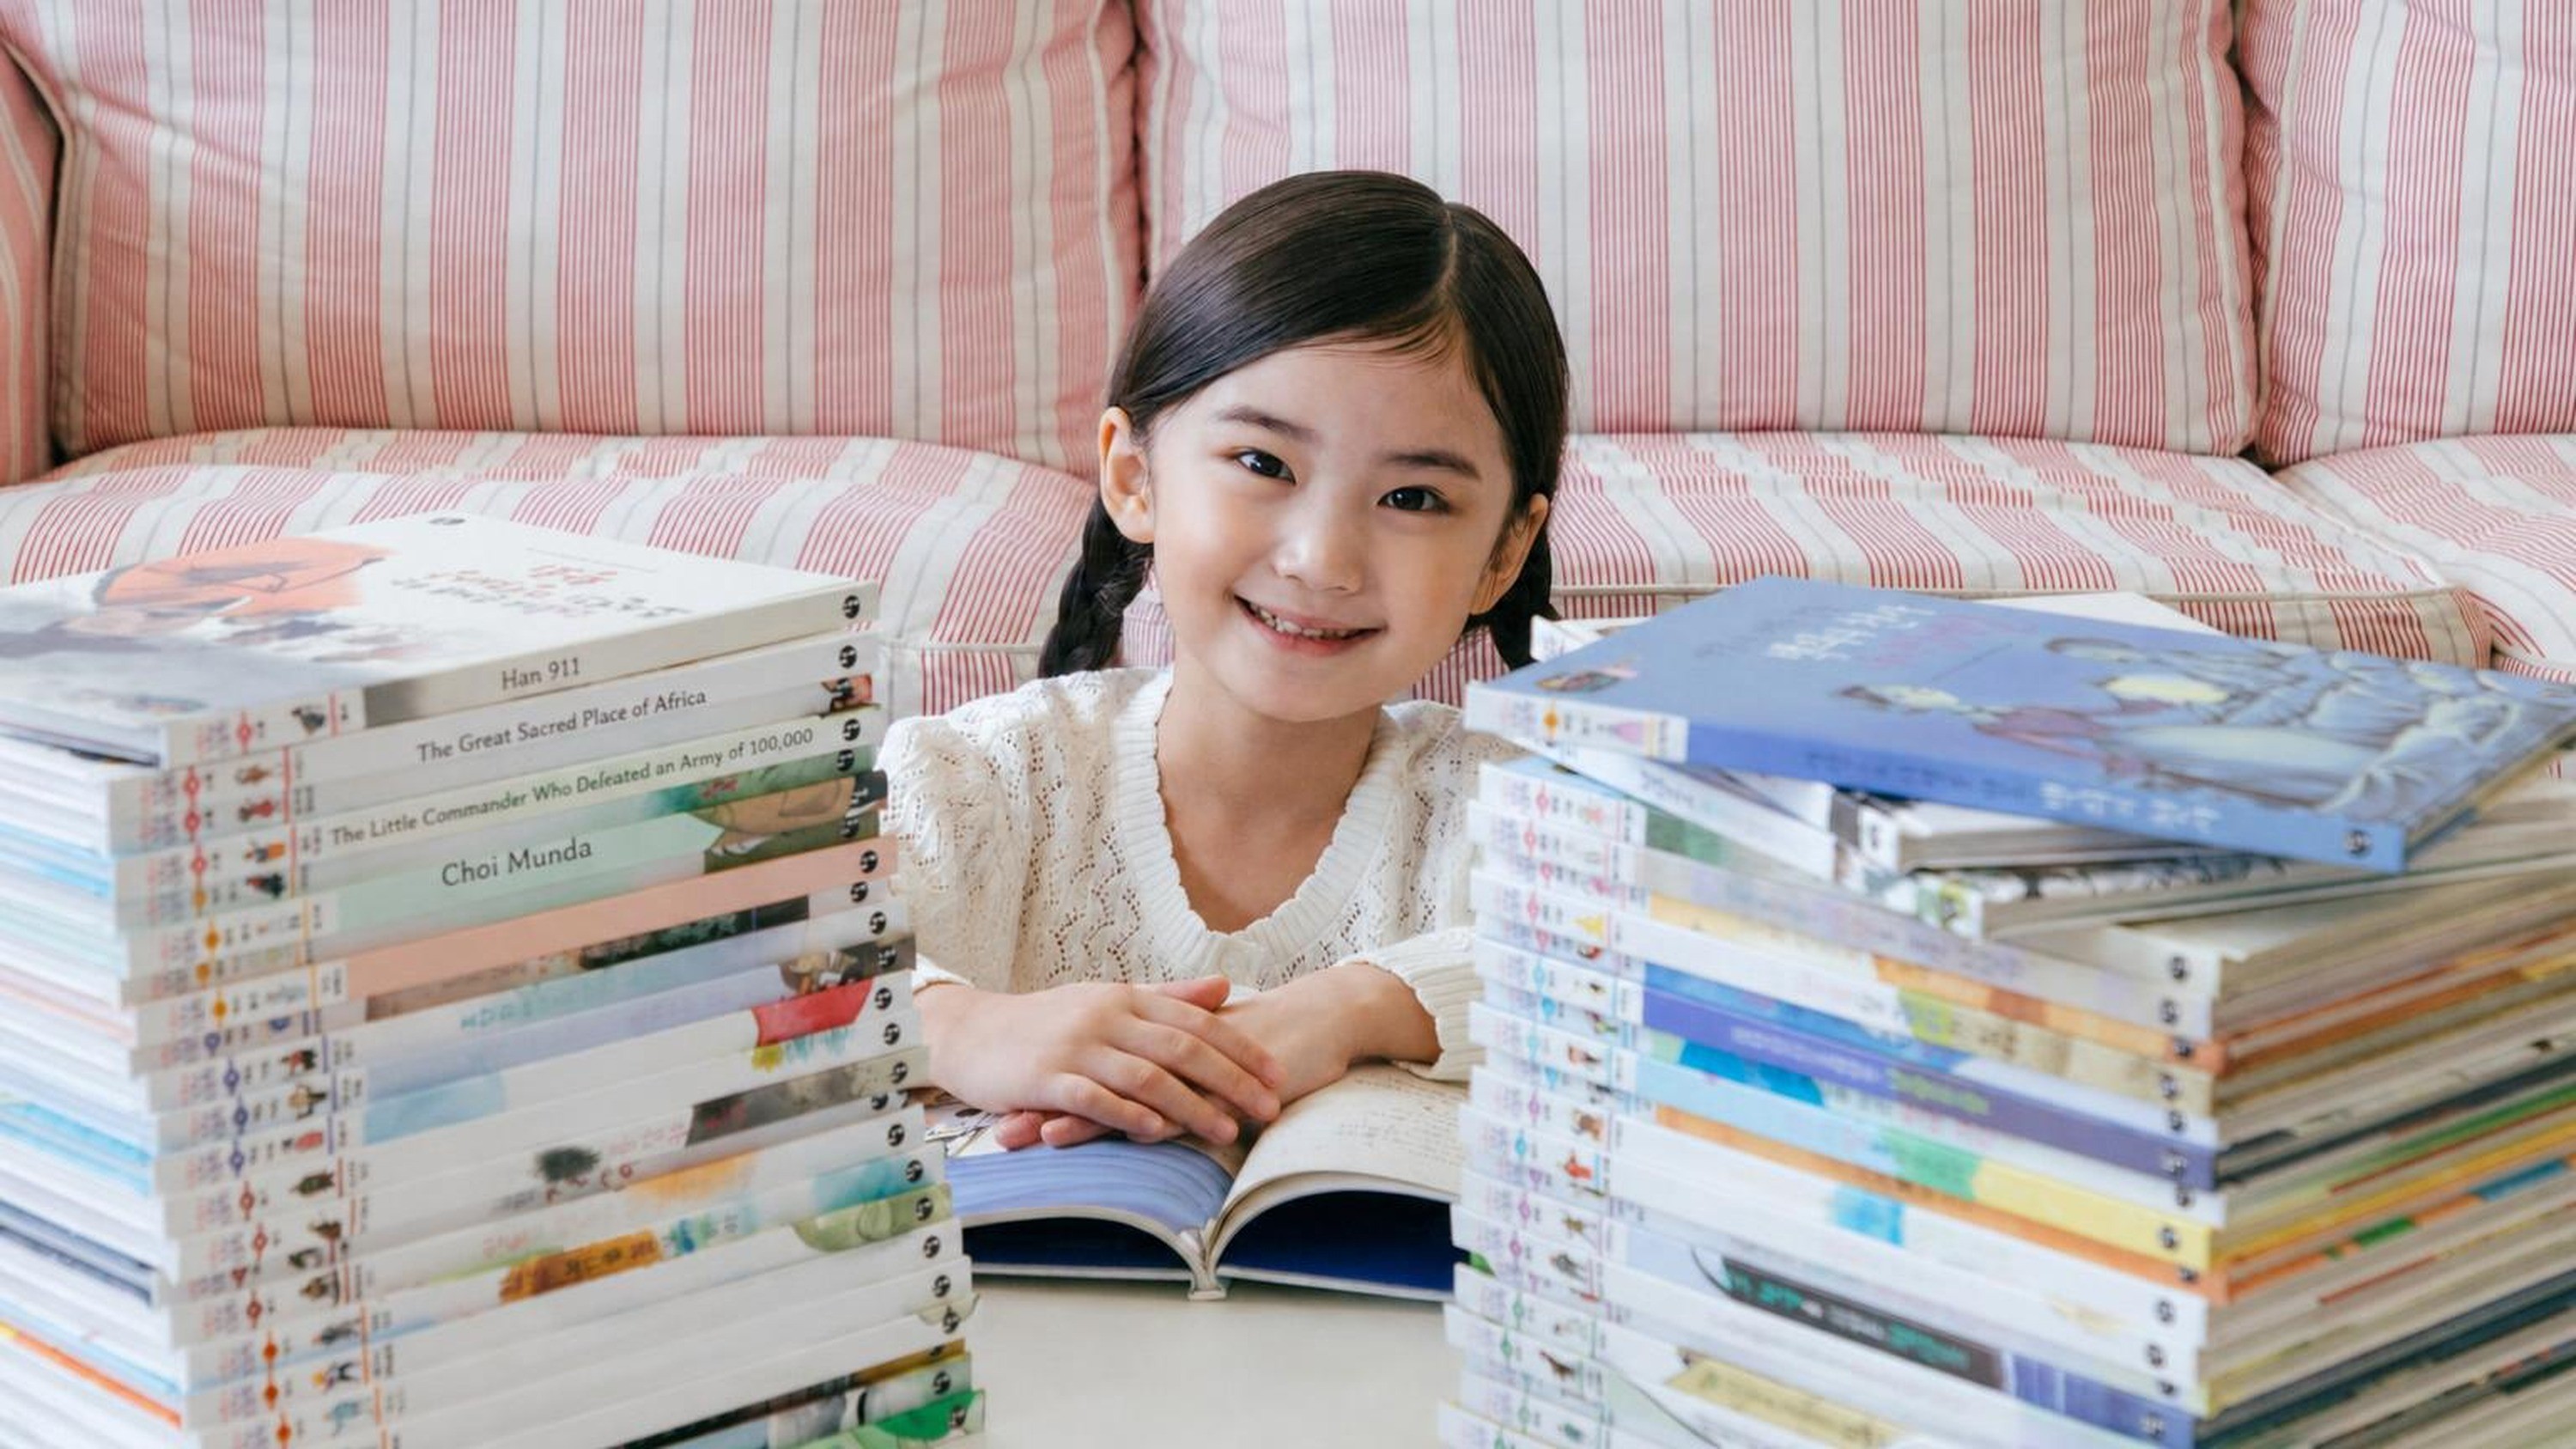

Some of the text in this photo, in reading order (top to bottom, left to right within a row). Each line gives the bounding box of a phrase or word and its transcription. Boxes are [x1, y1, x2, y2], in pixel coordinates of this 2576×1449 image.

[501, 658, 580, 690] Han 911
[416, 691, 706, 761] The Great Sacred Place of Africa
[331, 826, 365, 844] The
[370, 814, 416, 837] Little
[422, 793, 526, 826] Commander
[532, 782, 572, 801] Who
[577, 764, 650, 793] Defeated
[656, 762, 675, 775] an
[680, 752, 723, 770] Army
[728, 742, 744, 758] of
[750, 728, 813, 756] 100,000
[442, 837, 592, 886] Choi Munda
